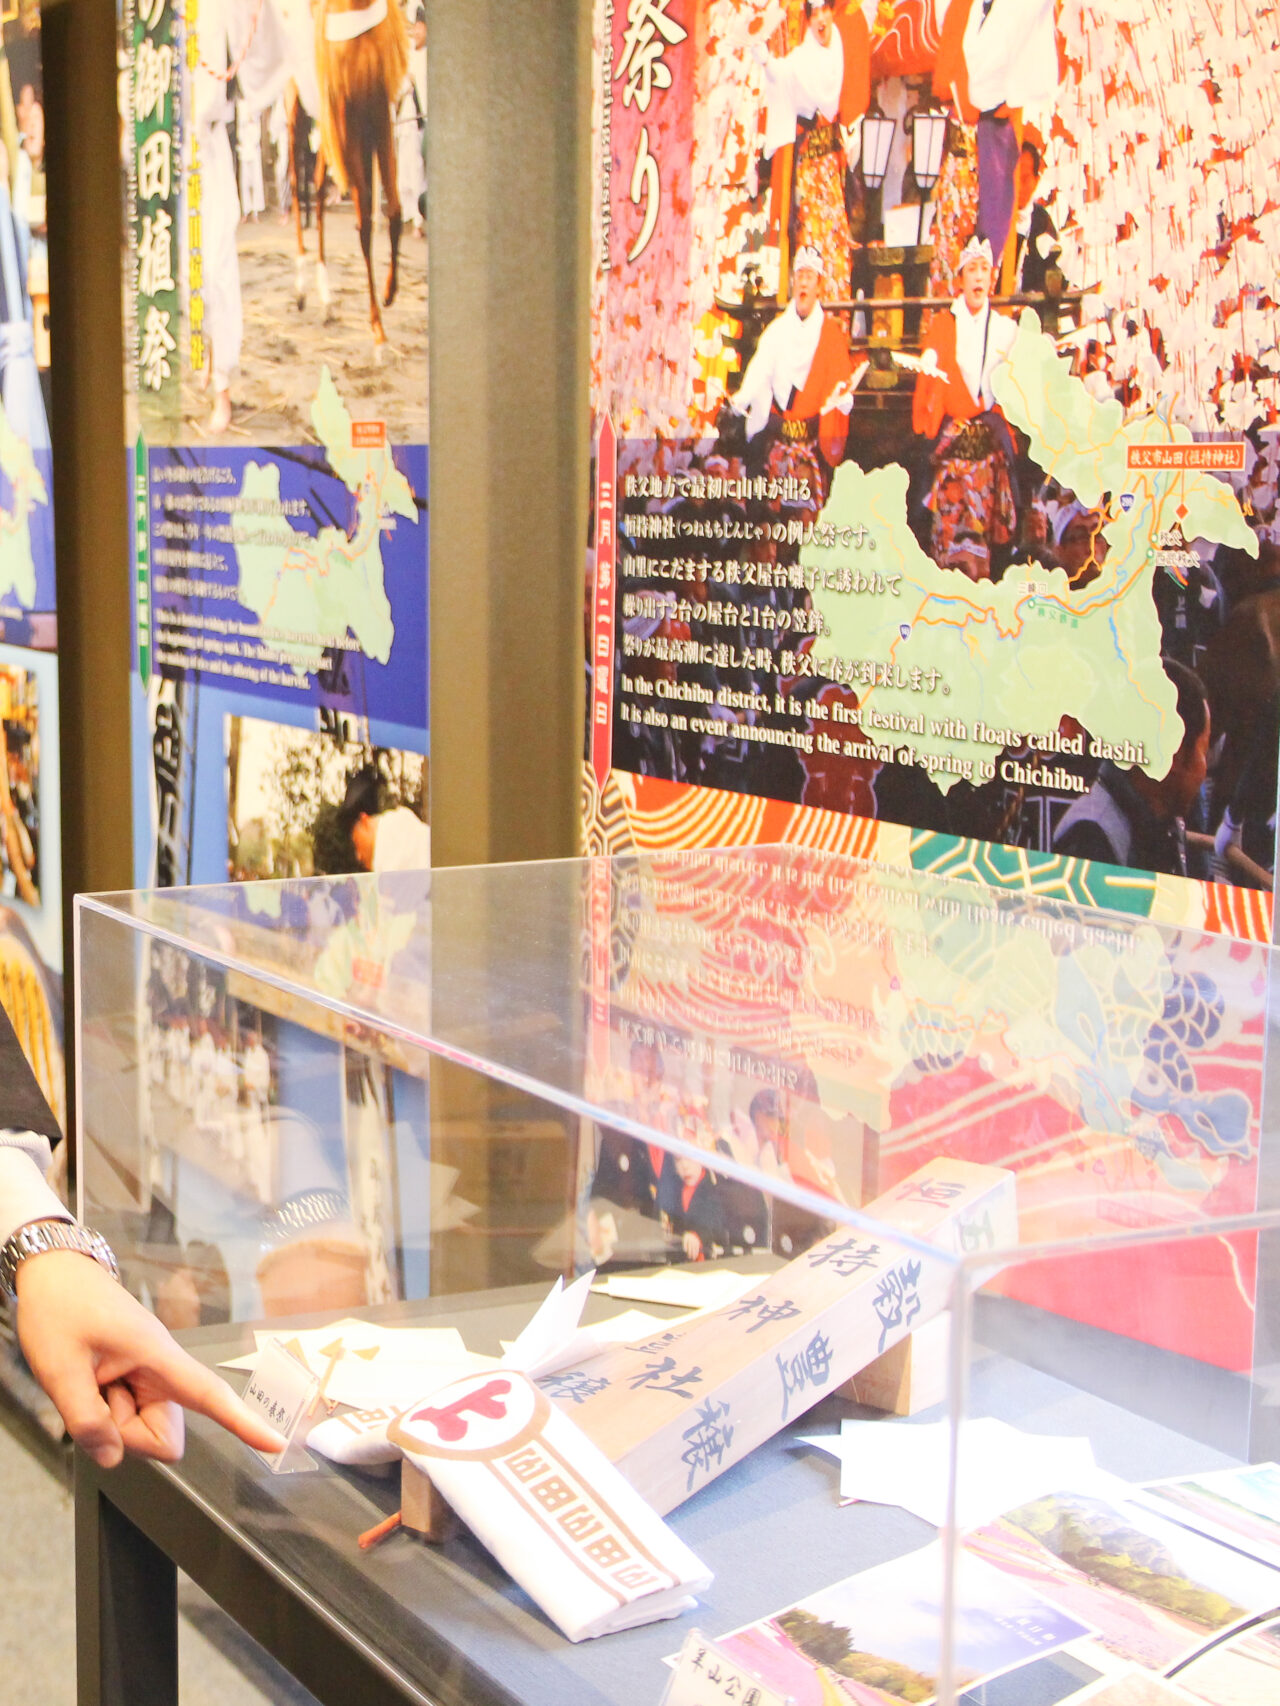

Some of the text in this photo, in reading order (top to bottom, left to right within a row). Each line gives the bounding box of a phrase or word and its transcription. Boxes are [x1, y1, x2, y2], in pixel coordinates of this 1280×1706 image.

[624, 475, 811, 502] 秩父地方で最初に山車が出る
[620, 702, 1090, 794] It is also an event announcing the arrival of spring to Chichibu.
[621, 673, 1149, 765] In the Chichibu district, it is the first festival with floats called dashi.
